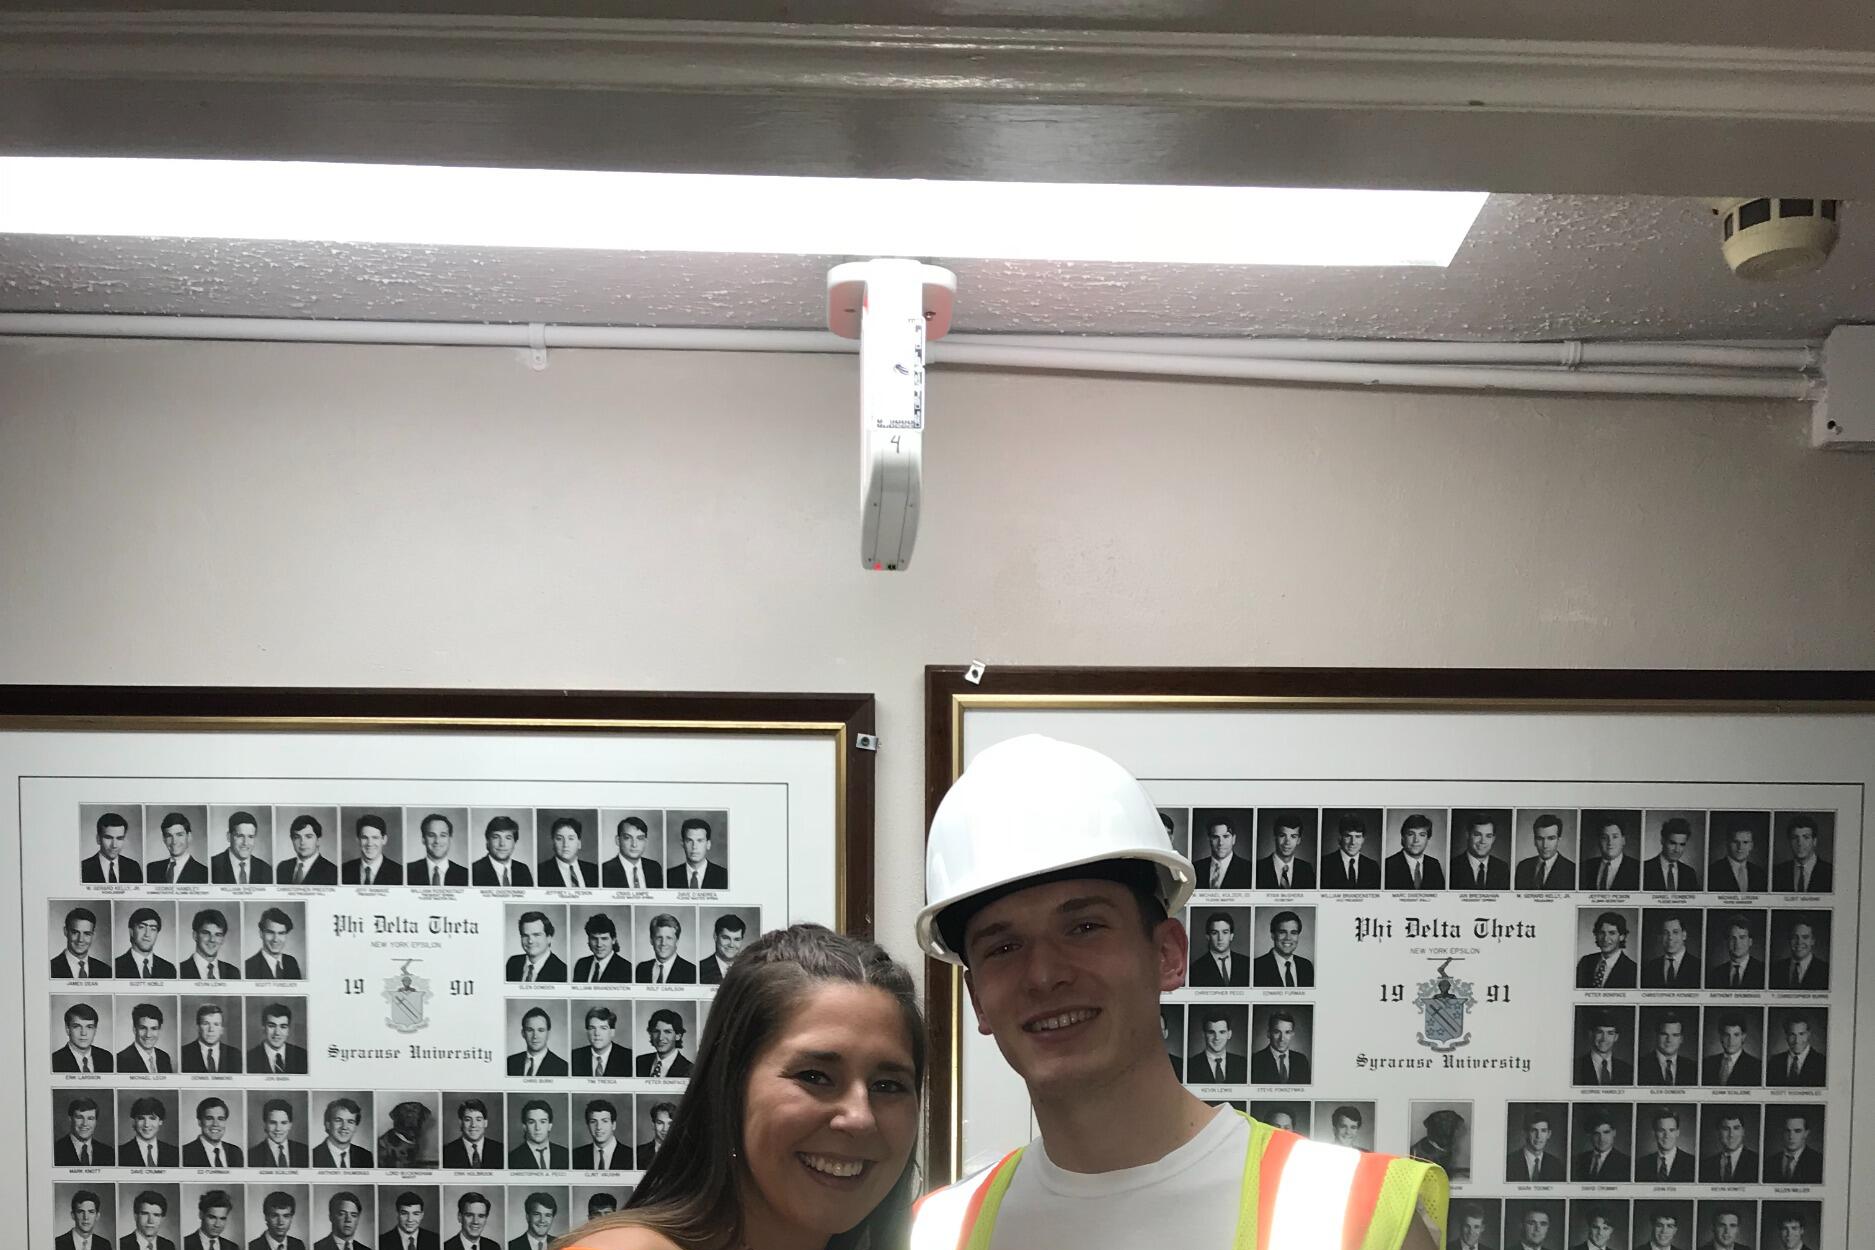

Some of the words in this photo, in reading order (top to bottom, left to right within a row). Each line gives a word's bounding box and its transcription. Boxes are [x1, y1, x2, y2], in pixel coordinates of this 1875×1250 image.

[890, 435, 901, 454] 4
[333, 914, 364, 938] Phi
[374, 915, 419, 934] Delta
[429, 915, 479, 938] Theta
[1355, 916, 1392, 943] Phi
[1405, 917, 1461, 939] Delta
[1473, 917, 1536, 943] Theta
[371, 941, 388, 949] NEW
[390, 941, 410, 949] YORK
[411, 941, 442, 949] EPSILON
[1410, 947, 1426, 955] NEW
[1427, 947, 1448, 955] YORK
[1449, 947, 1480, 955] EPSILON
[344, 978, 365, 995] 19
[450, 979, 475, 996] 90
[1379, 984, 1405, 1002] 19
[1486, 984, 1511, 1003] 91
[328, 1044, 401, 1062] Syracuse
[409, 1045, 493, 1063] University
[1356, 1053, 1433, 1071] Syracuse
[1443, 1054, 1531, 1073] University
